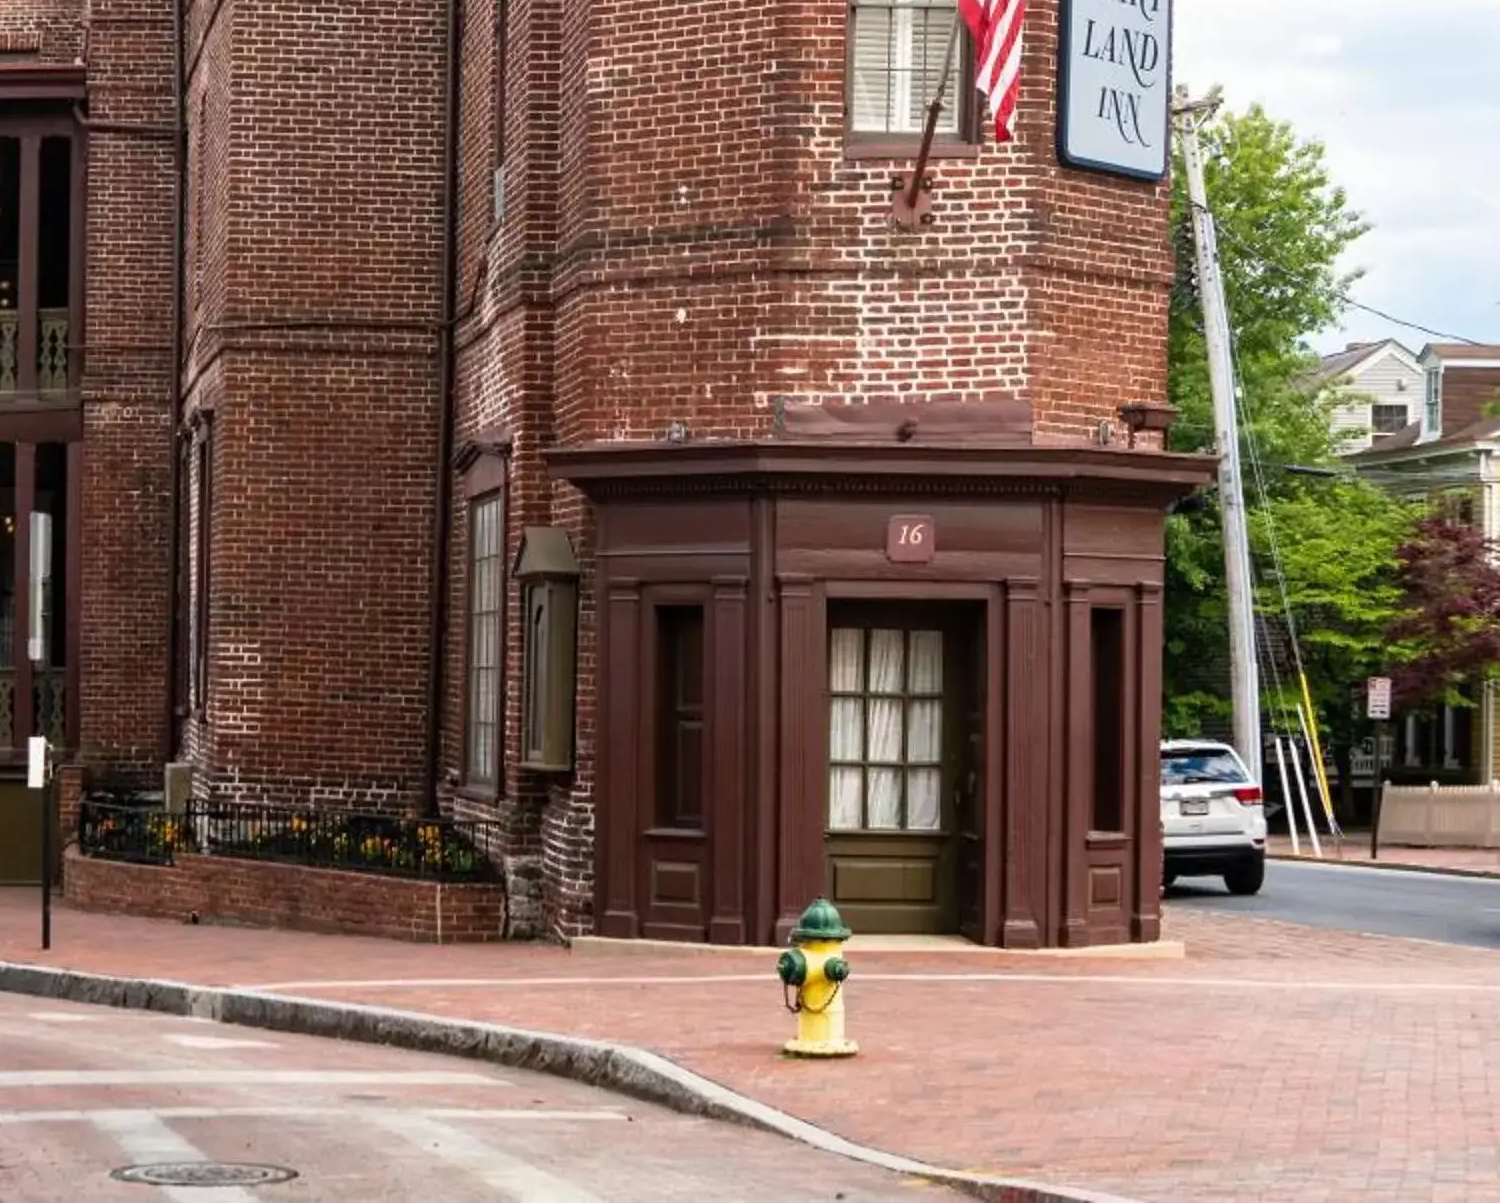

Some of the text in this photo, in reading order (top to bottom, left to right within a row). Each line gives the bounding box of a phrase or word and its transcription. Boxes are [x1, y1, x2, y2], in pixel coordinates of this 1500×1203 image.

[1082, 19, 1159, 89] LAND
[1097, 86, 1151, 148] INN
[898, 524, 924, 544] 16
